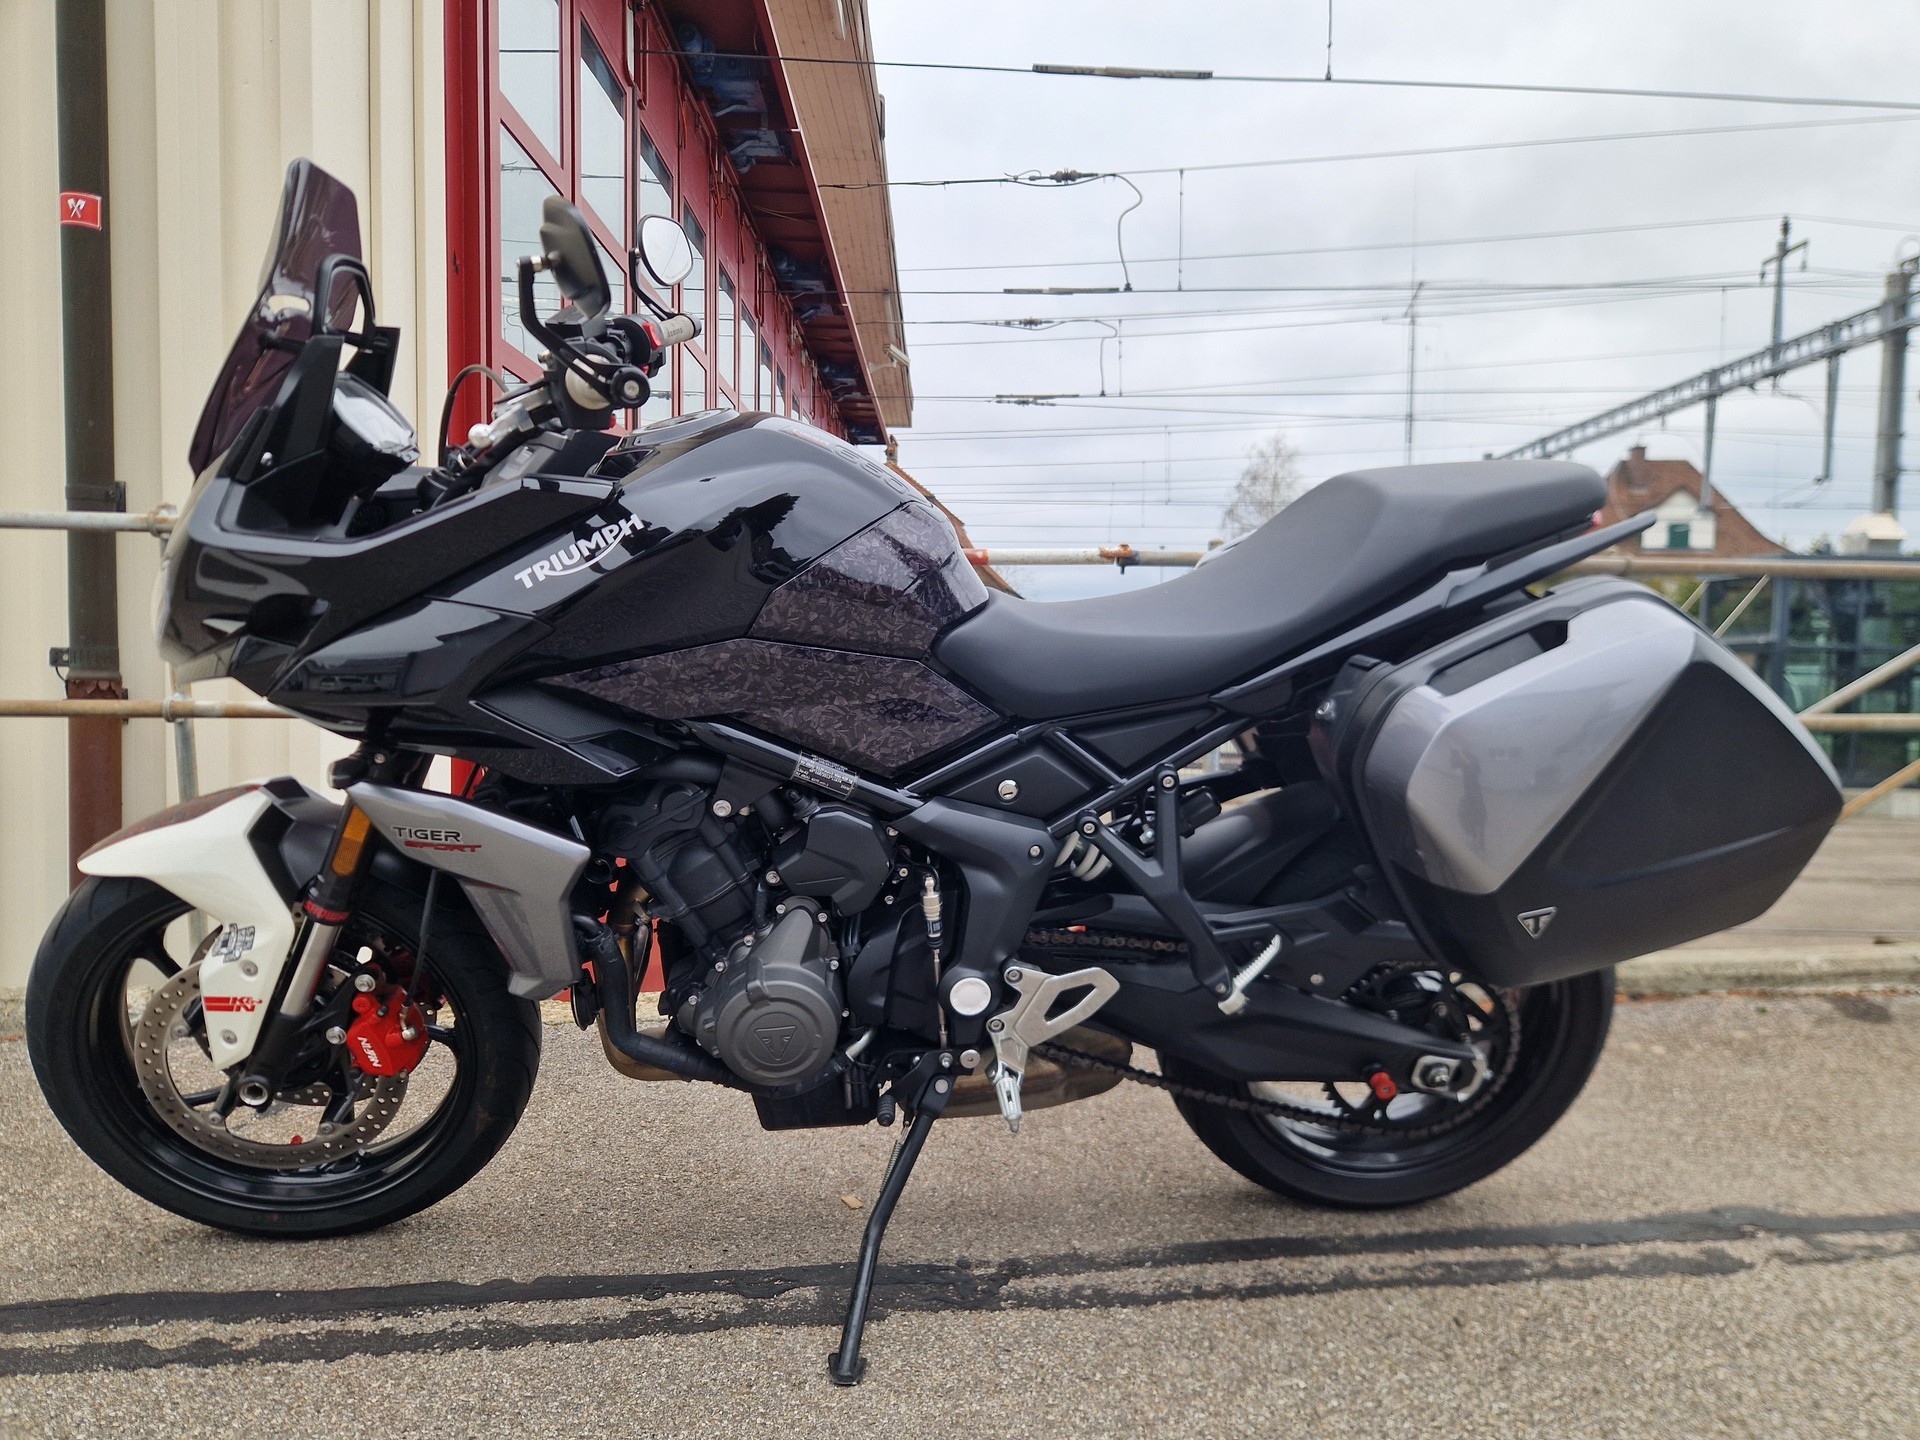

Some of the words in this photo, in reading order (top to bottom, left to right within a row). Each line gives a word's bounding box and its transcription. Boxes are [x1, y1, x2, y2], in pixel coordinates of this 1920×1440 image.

[514, 513, 645, 589] TRIUMPH
[393, 826, 462, 843] TIGER
[404, 840, 482, 853] SPORT
